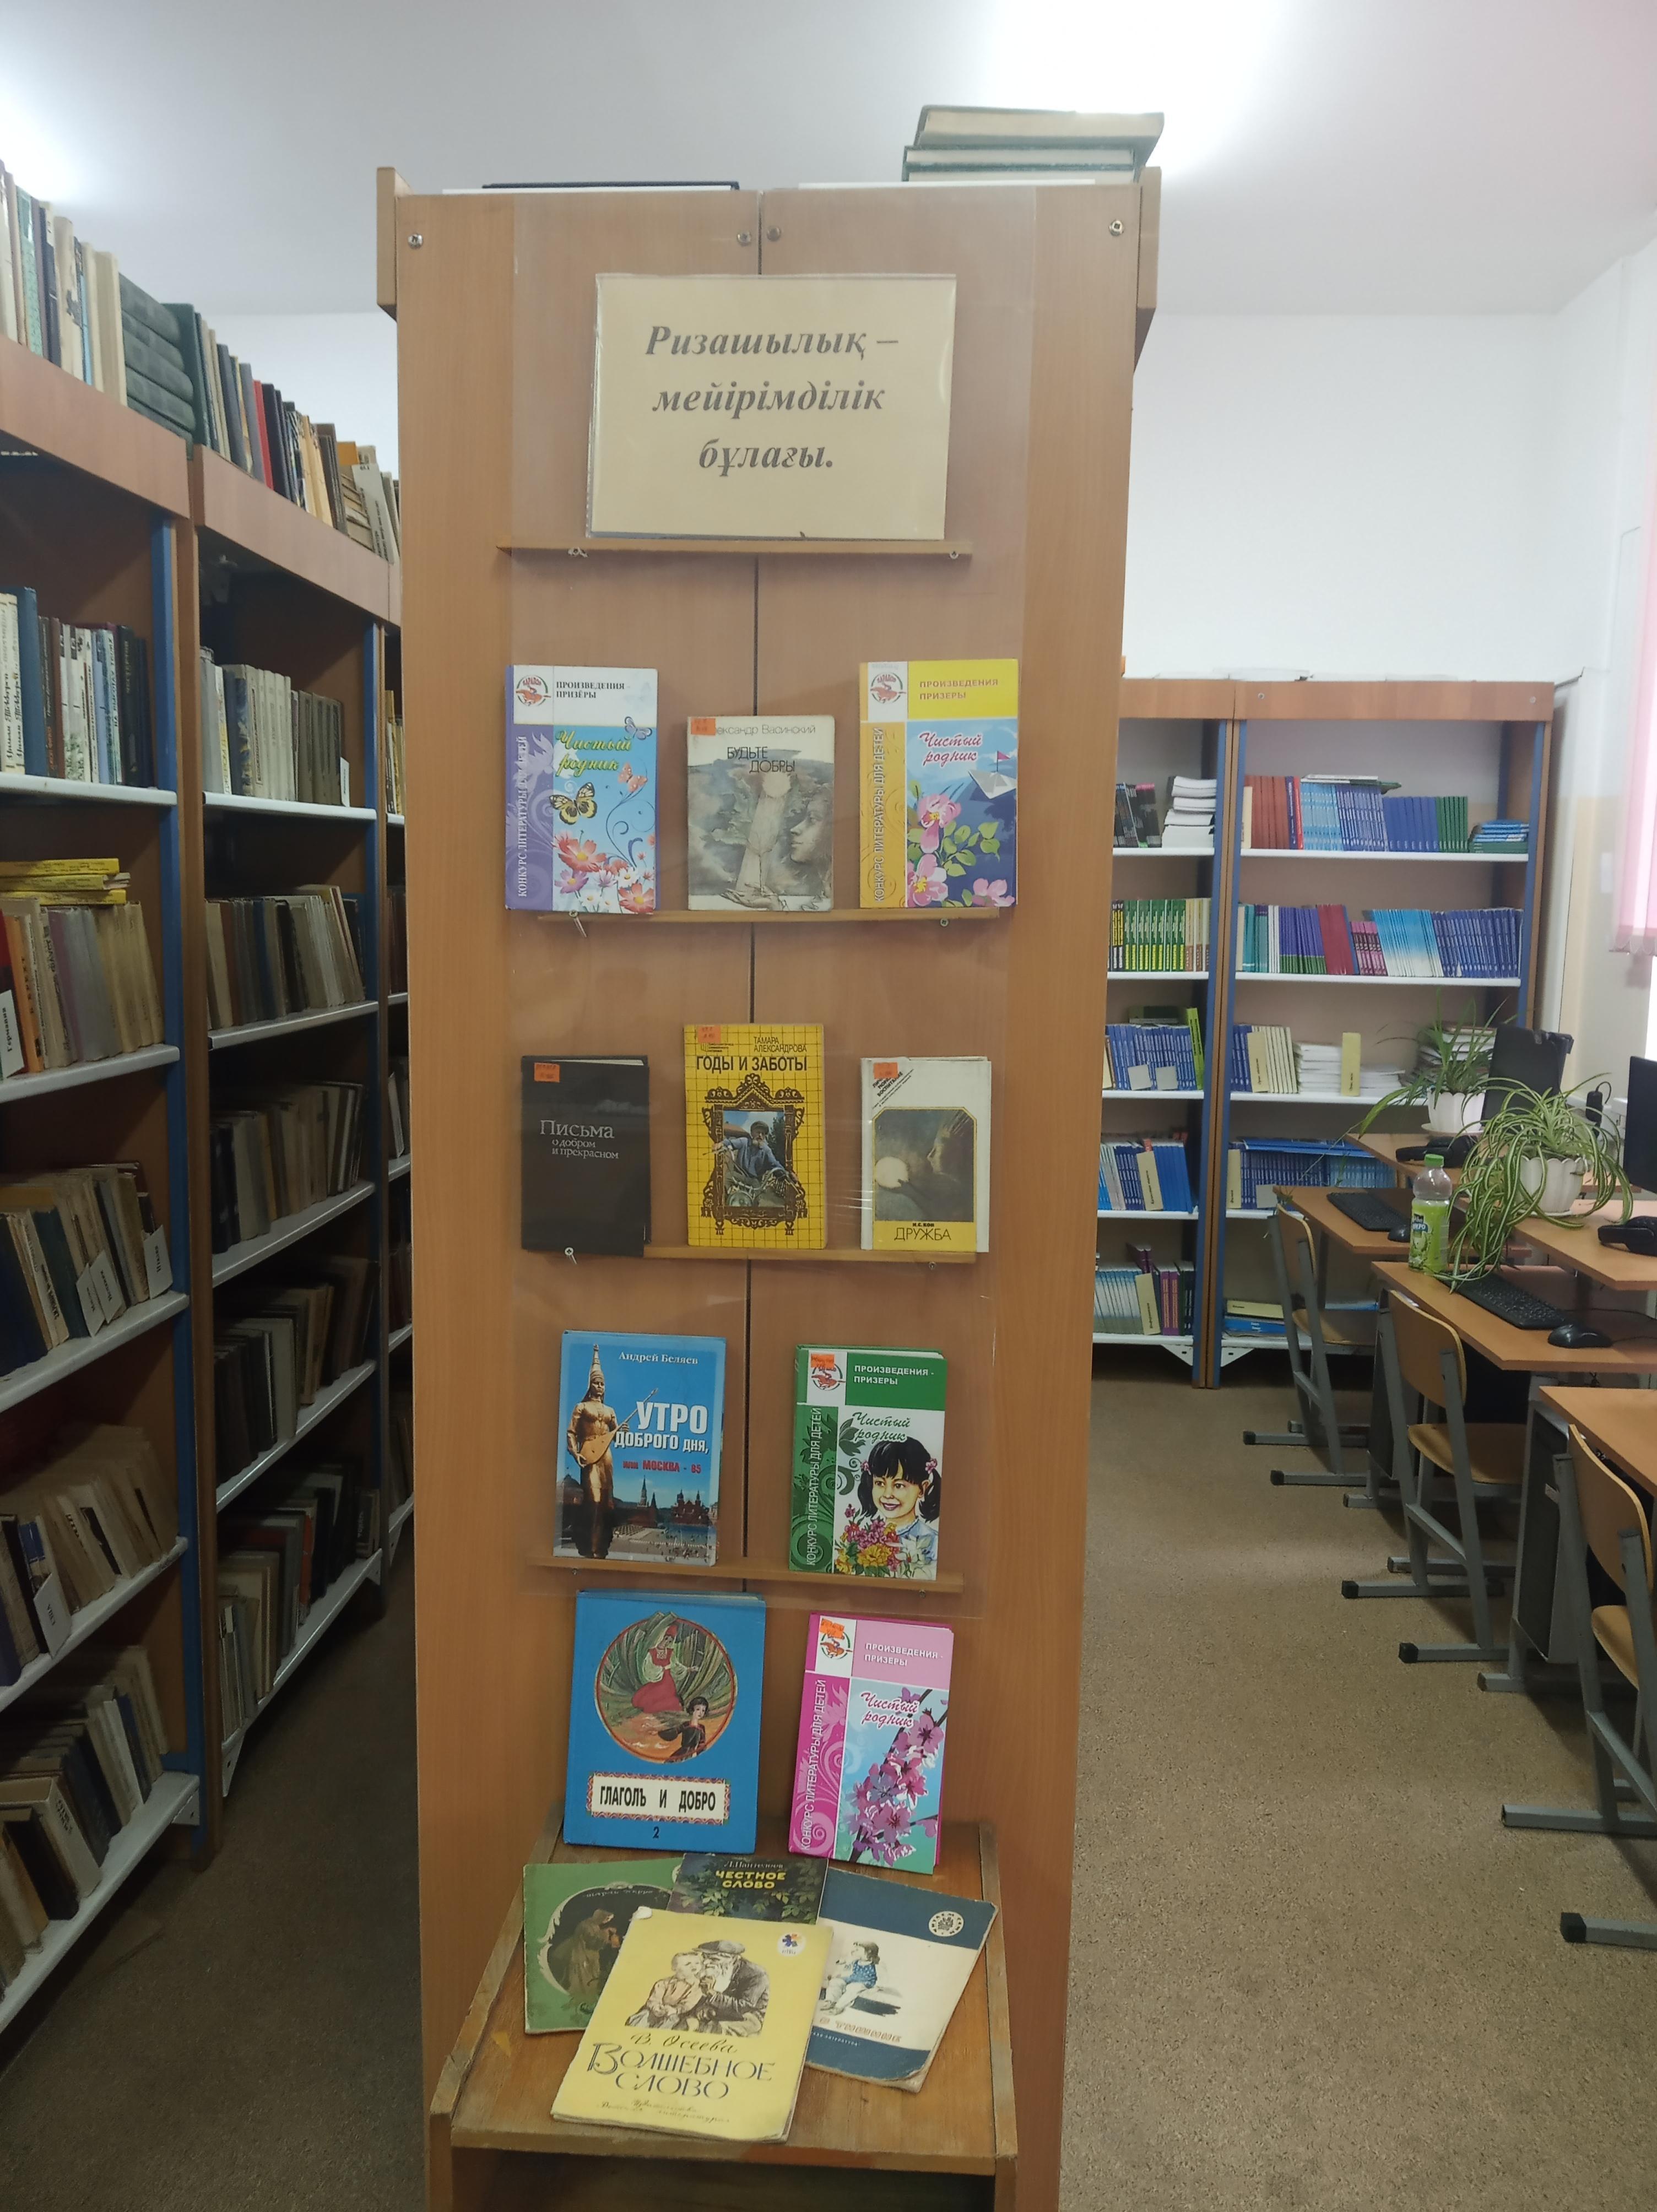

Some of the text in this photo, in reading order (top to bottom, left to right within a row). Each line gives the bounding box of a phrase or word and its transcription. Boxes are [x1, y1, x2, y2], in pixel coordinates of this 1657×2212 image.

[646, 326, 867, 361] Ризашылық
[652, 380, 886, 420] мейірімділік
[698, 438, 833, 477] бұлағы.
[556, 681, 625, 690] ПРОИЗВЕДЕНИЯ
[919, 679, 999, 688] ПРОИЗВЕДЕНИЯ
[919, 692, 966, 700] ПРИЗЕРЫ
[716, 725, 759, 738] ександр
[761, 724, 815, 734] Васинский
[918, 731, 983, 748] Чистый
[555, 729, 632, 751] Чистый
[727, 746, 768, 760] БУДЬТЕ
[923, 750, 978, 768] родник
[555, 753, 620, 777] родник
[749, 760, 795, 773] ДОБРЫ
[518, 790, 528, 852] ЛИТЕРАТУРЫ
[873, 728, 884, 902] КОНКУРС ЛИТЕРАТУРЫ ДЛЯ ДЕТЕЙ
[518, 854, 527, 897] КОНКУРС
[754, 1036, 779, 1044] ТАМАРА
[754, 1044, 807, 1054] АЛЕКСАНДРОВА
[696, 1056, 807, 1074] ГОДЫ И ЗАБОТЫ
[539, 1120, 615, 1138] Письма
[559, 1138, 596, 1151] добром
[560, 1148, 619, 1159] прекрасном
[894, 1228, 951, 1241] ДРУЖБА
[618, 1352, 698, 1365] Андрей Беляев
[854, 1365, 929, 1376] ПРОИЗВЕДЕНИЯ
[854, 1376, 898, 1385] ПРИЗЕРЫ
[636, 1401, 708, 1434] УТРО
[852, 1412, 911, 1428] Чистый
[614, 1432, 679, 1450] ДОБРОГО
[854, 1428, 908, 1444] родник
[642, 1460, 680, 1473] МОСКВА
[806, 1407, 822, 1566] КОНКУРС ЛИТЕРАТУРЫ ДЛЯ ДЕТЕЙ
[865, 1642, 938, 1659] ПРОИЗВЕДЕНИЯ
[864, 1653, 908, 1666] ПРИЗЕРЫ
[860, 1691, 919, 1714] Чистый
[861, 1709, 914, 1728] родник
[800, 1679, 827, 1851] КОНКУРС ЛИТЕРАТУРЫ ДЛЯ ДЕТЕЙ
[600, 1786, 716, 1813] ГЛАГОЛЪ И ДОБРО
[653, 1826, 659, 1839] 2
[716, 1871, 786, 1880] ЧЕСТНОЕ
[722, 1880, 775, 1889] СЛОВО
[630, 2032, 738, 2054] В. Осеева
[587, 2042, 776, 2081] ВОЛШЕБНОЕ
[616, 2072, 729, 2099] СЛОВО
